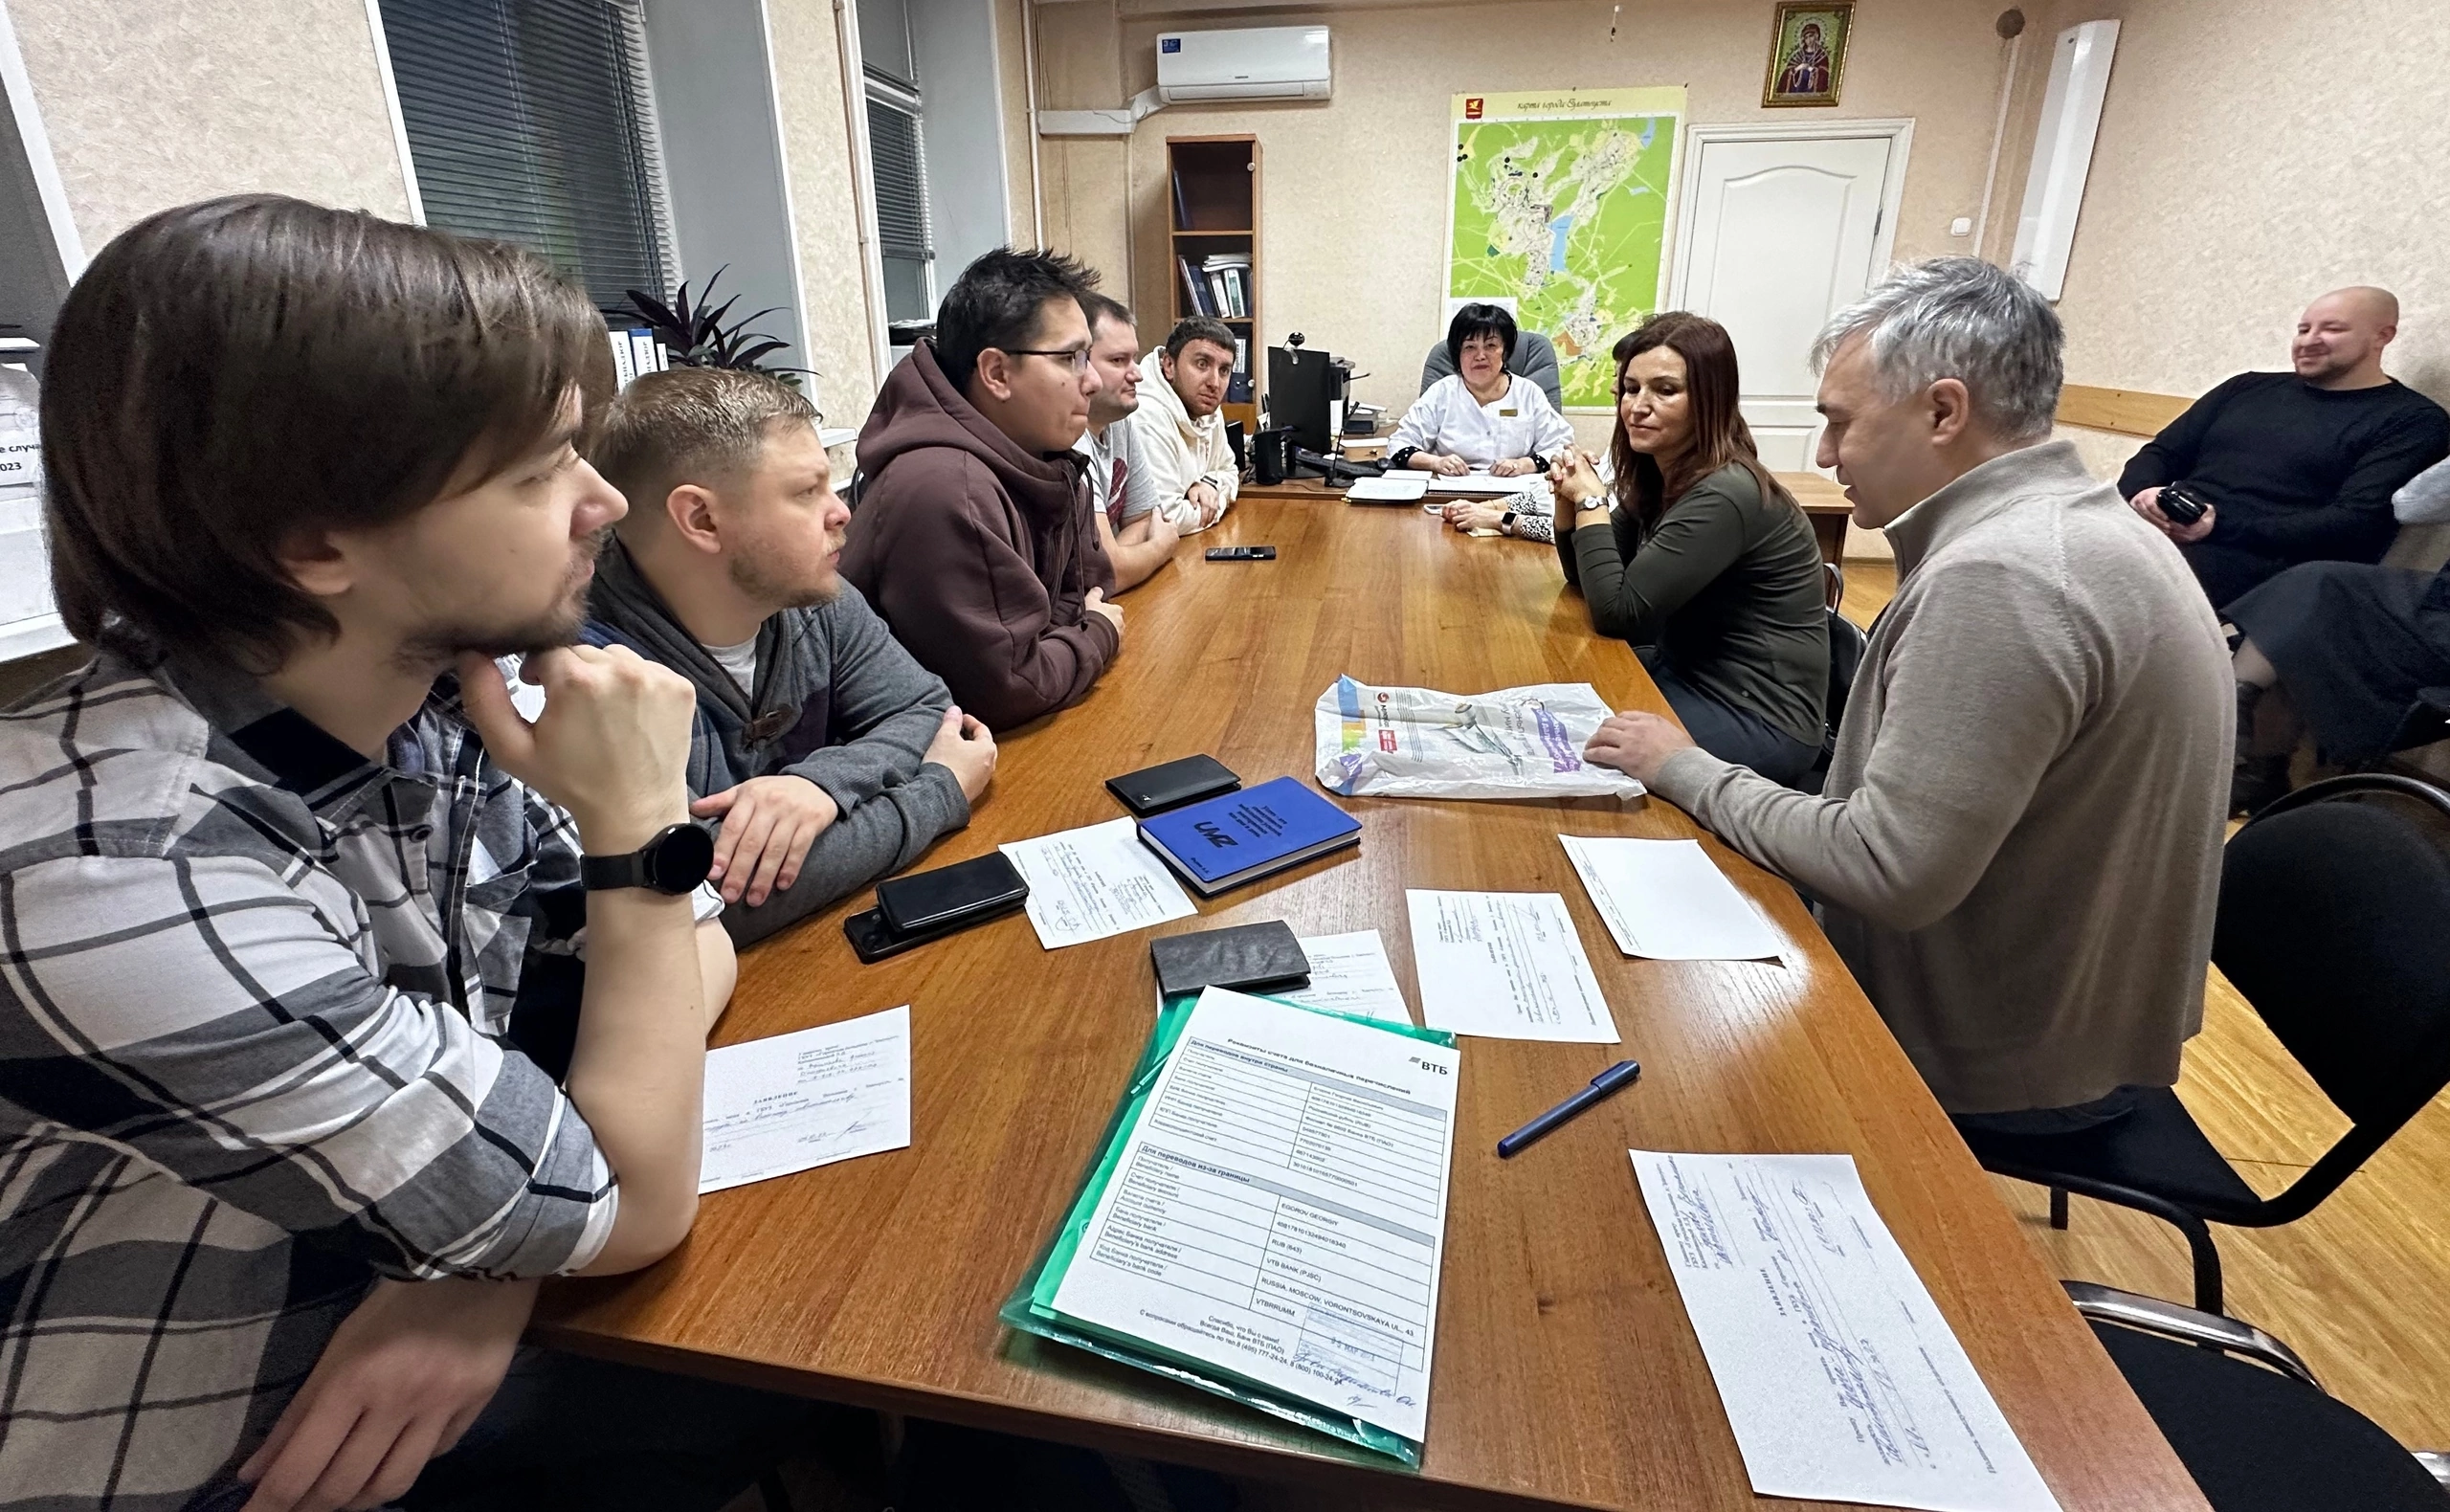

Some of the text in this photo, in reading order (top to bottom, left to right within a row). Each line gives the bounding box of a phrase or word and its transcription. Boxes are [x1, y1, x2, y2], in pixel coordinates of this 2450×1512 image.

[1204, 1044, 1239, 1057] переводов
[1421, 1060, 1448, 1075] ВТБ
[1141, 1145, 1250, 1186] Для переводов из-за границы
[1281, 1202, 1309, 1216] EGOROV
[1271, 1238, 1303, 1255] RUB (643)
[1266, 1257, 1322, 1282] VTB BANK (PJSC)
[1255, 1298, 1295, 1317] VTBRRUMM
[1324, 1299, 1390, 1327] VORONTSOVSKAYA
[1251, 1337, 1265, 1347] ВТБ
[1264, 1342, 1284, 1355] (ПАО)
